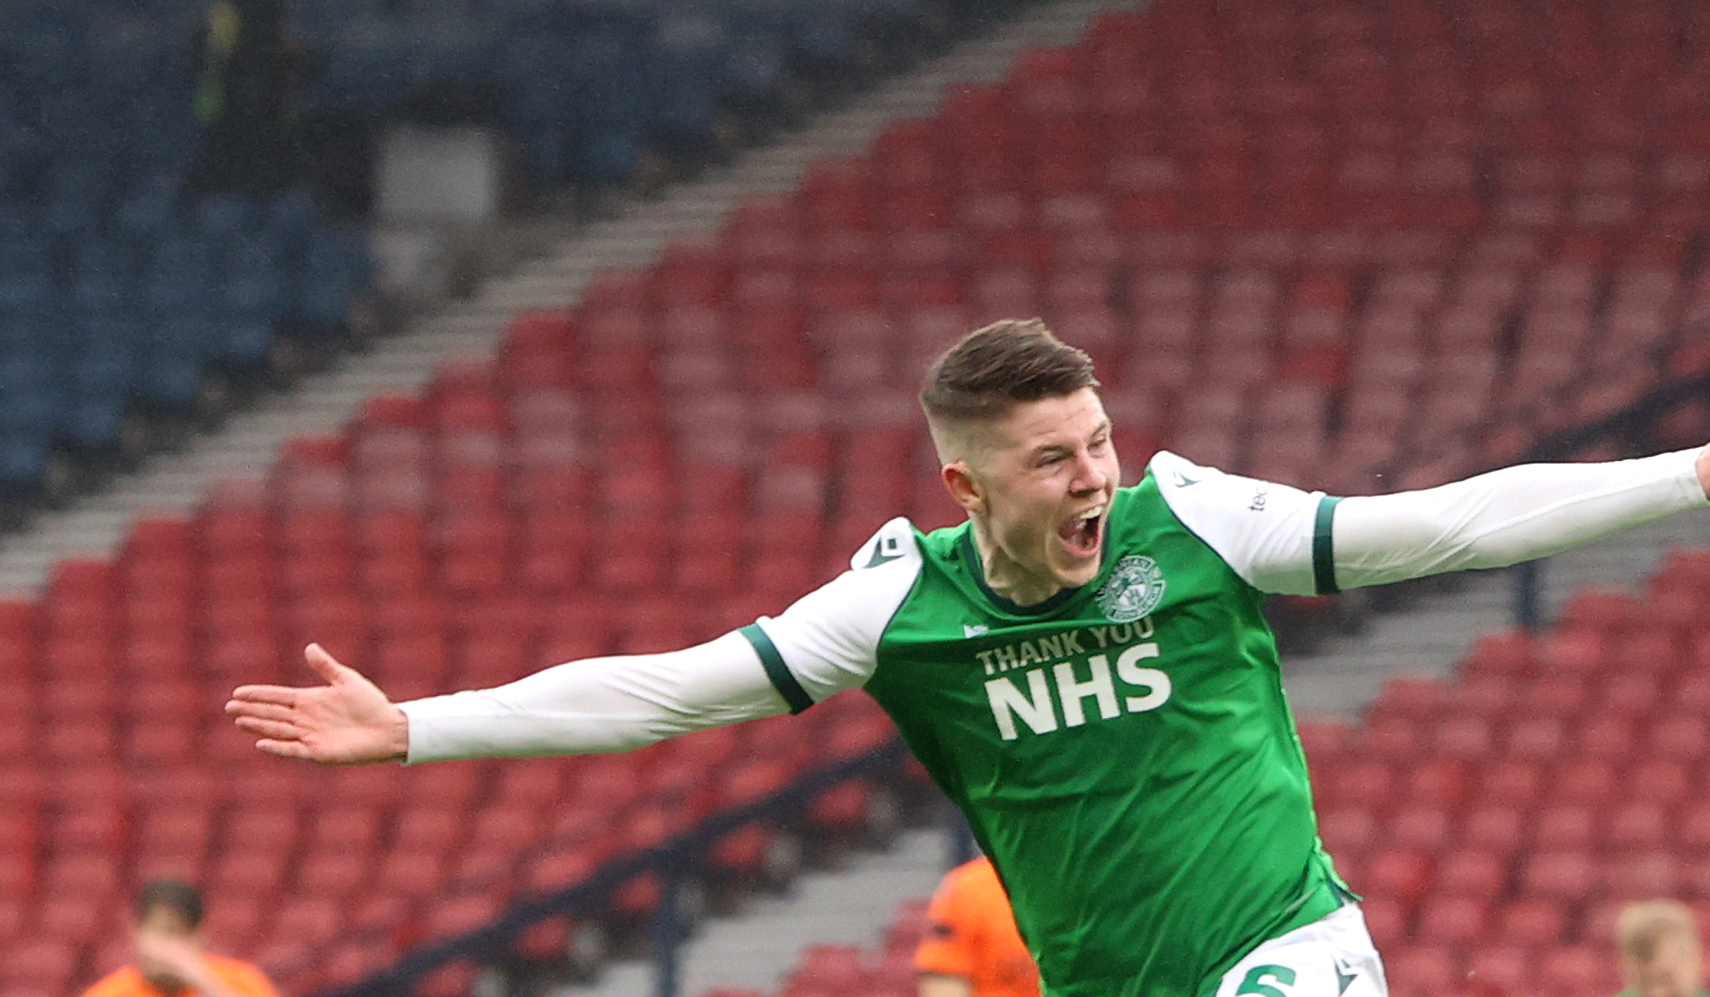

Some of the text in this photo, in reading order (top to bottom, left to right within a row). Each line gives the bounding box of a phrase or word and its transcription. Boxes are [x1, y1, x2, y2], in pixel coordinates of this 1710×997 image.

[976, 615, 1155, 676] THANK YOU
[984, 642, 1172, 741] NHS
